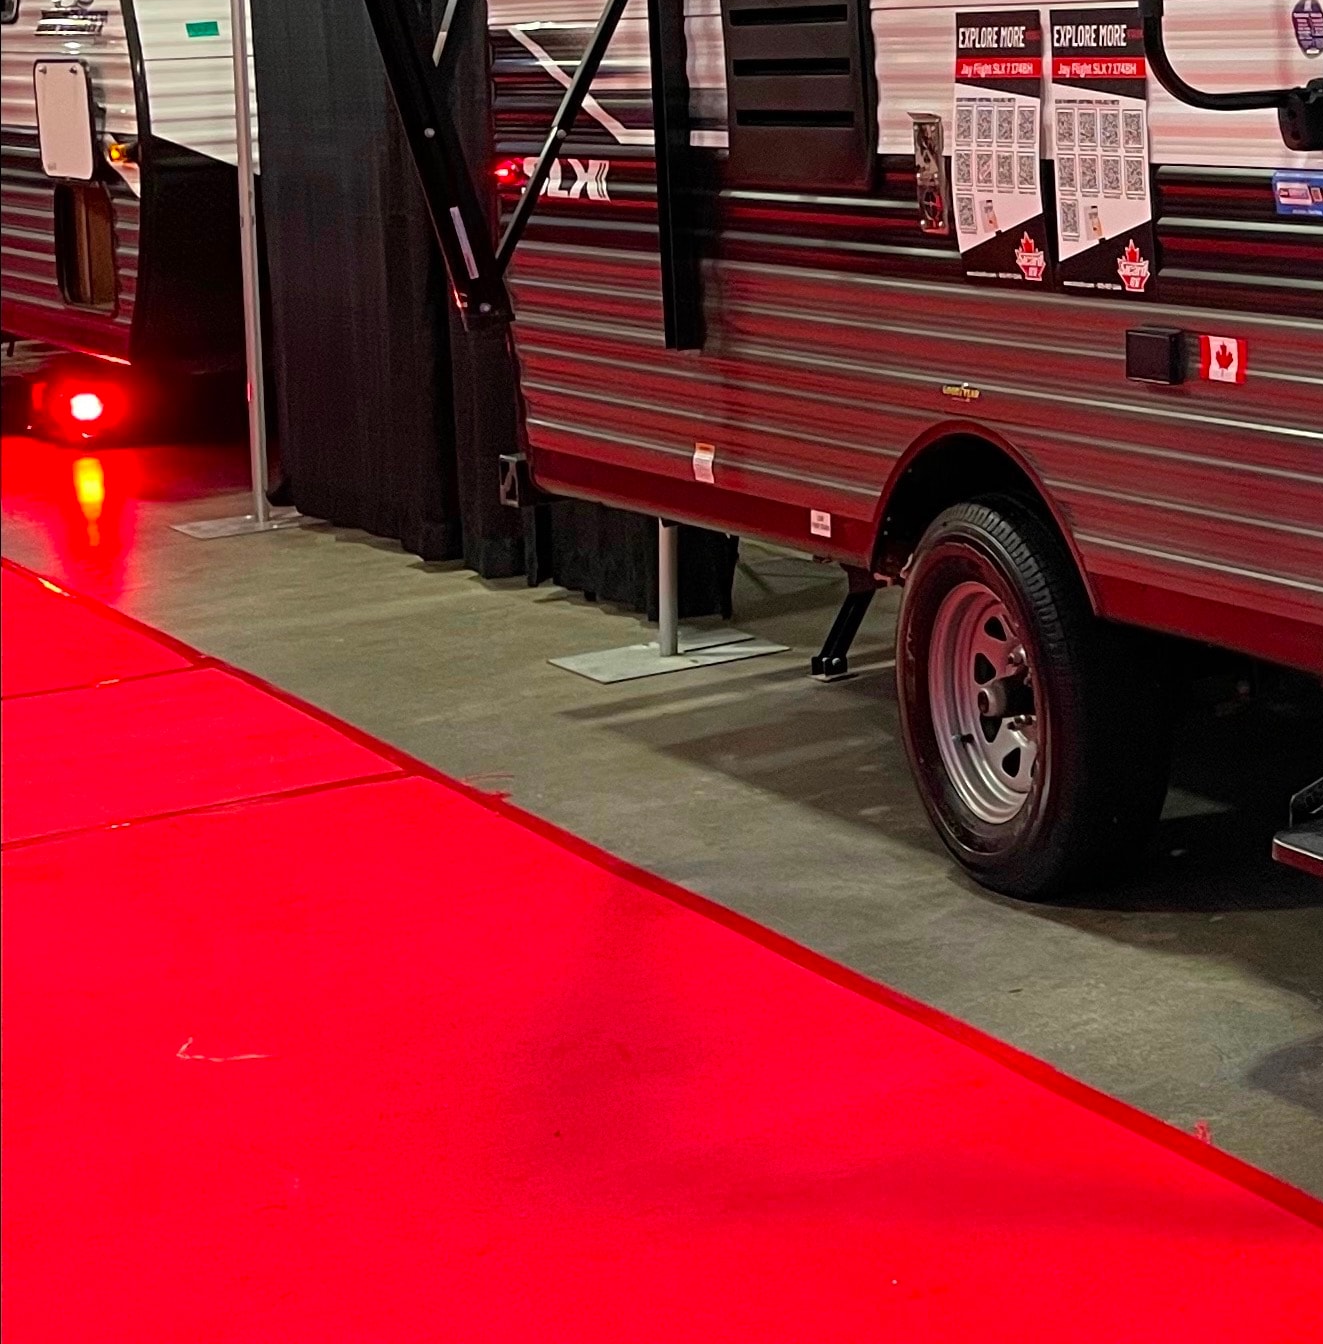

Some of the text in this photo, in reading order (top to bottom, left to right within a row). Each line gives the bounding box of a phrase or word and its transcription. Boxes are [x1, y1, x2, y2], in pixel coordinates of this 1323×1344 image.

[958, 26, 1026, 49] EXPLORE MORE
[1053, 24, 1127, 47] EXPLORE MORE
[961, 63, 973, 77] Jay
[1058, 63, 1070, 77] Jay
[1072, 62, 1092, 77] Flight
